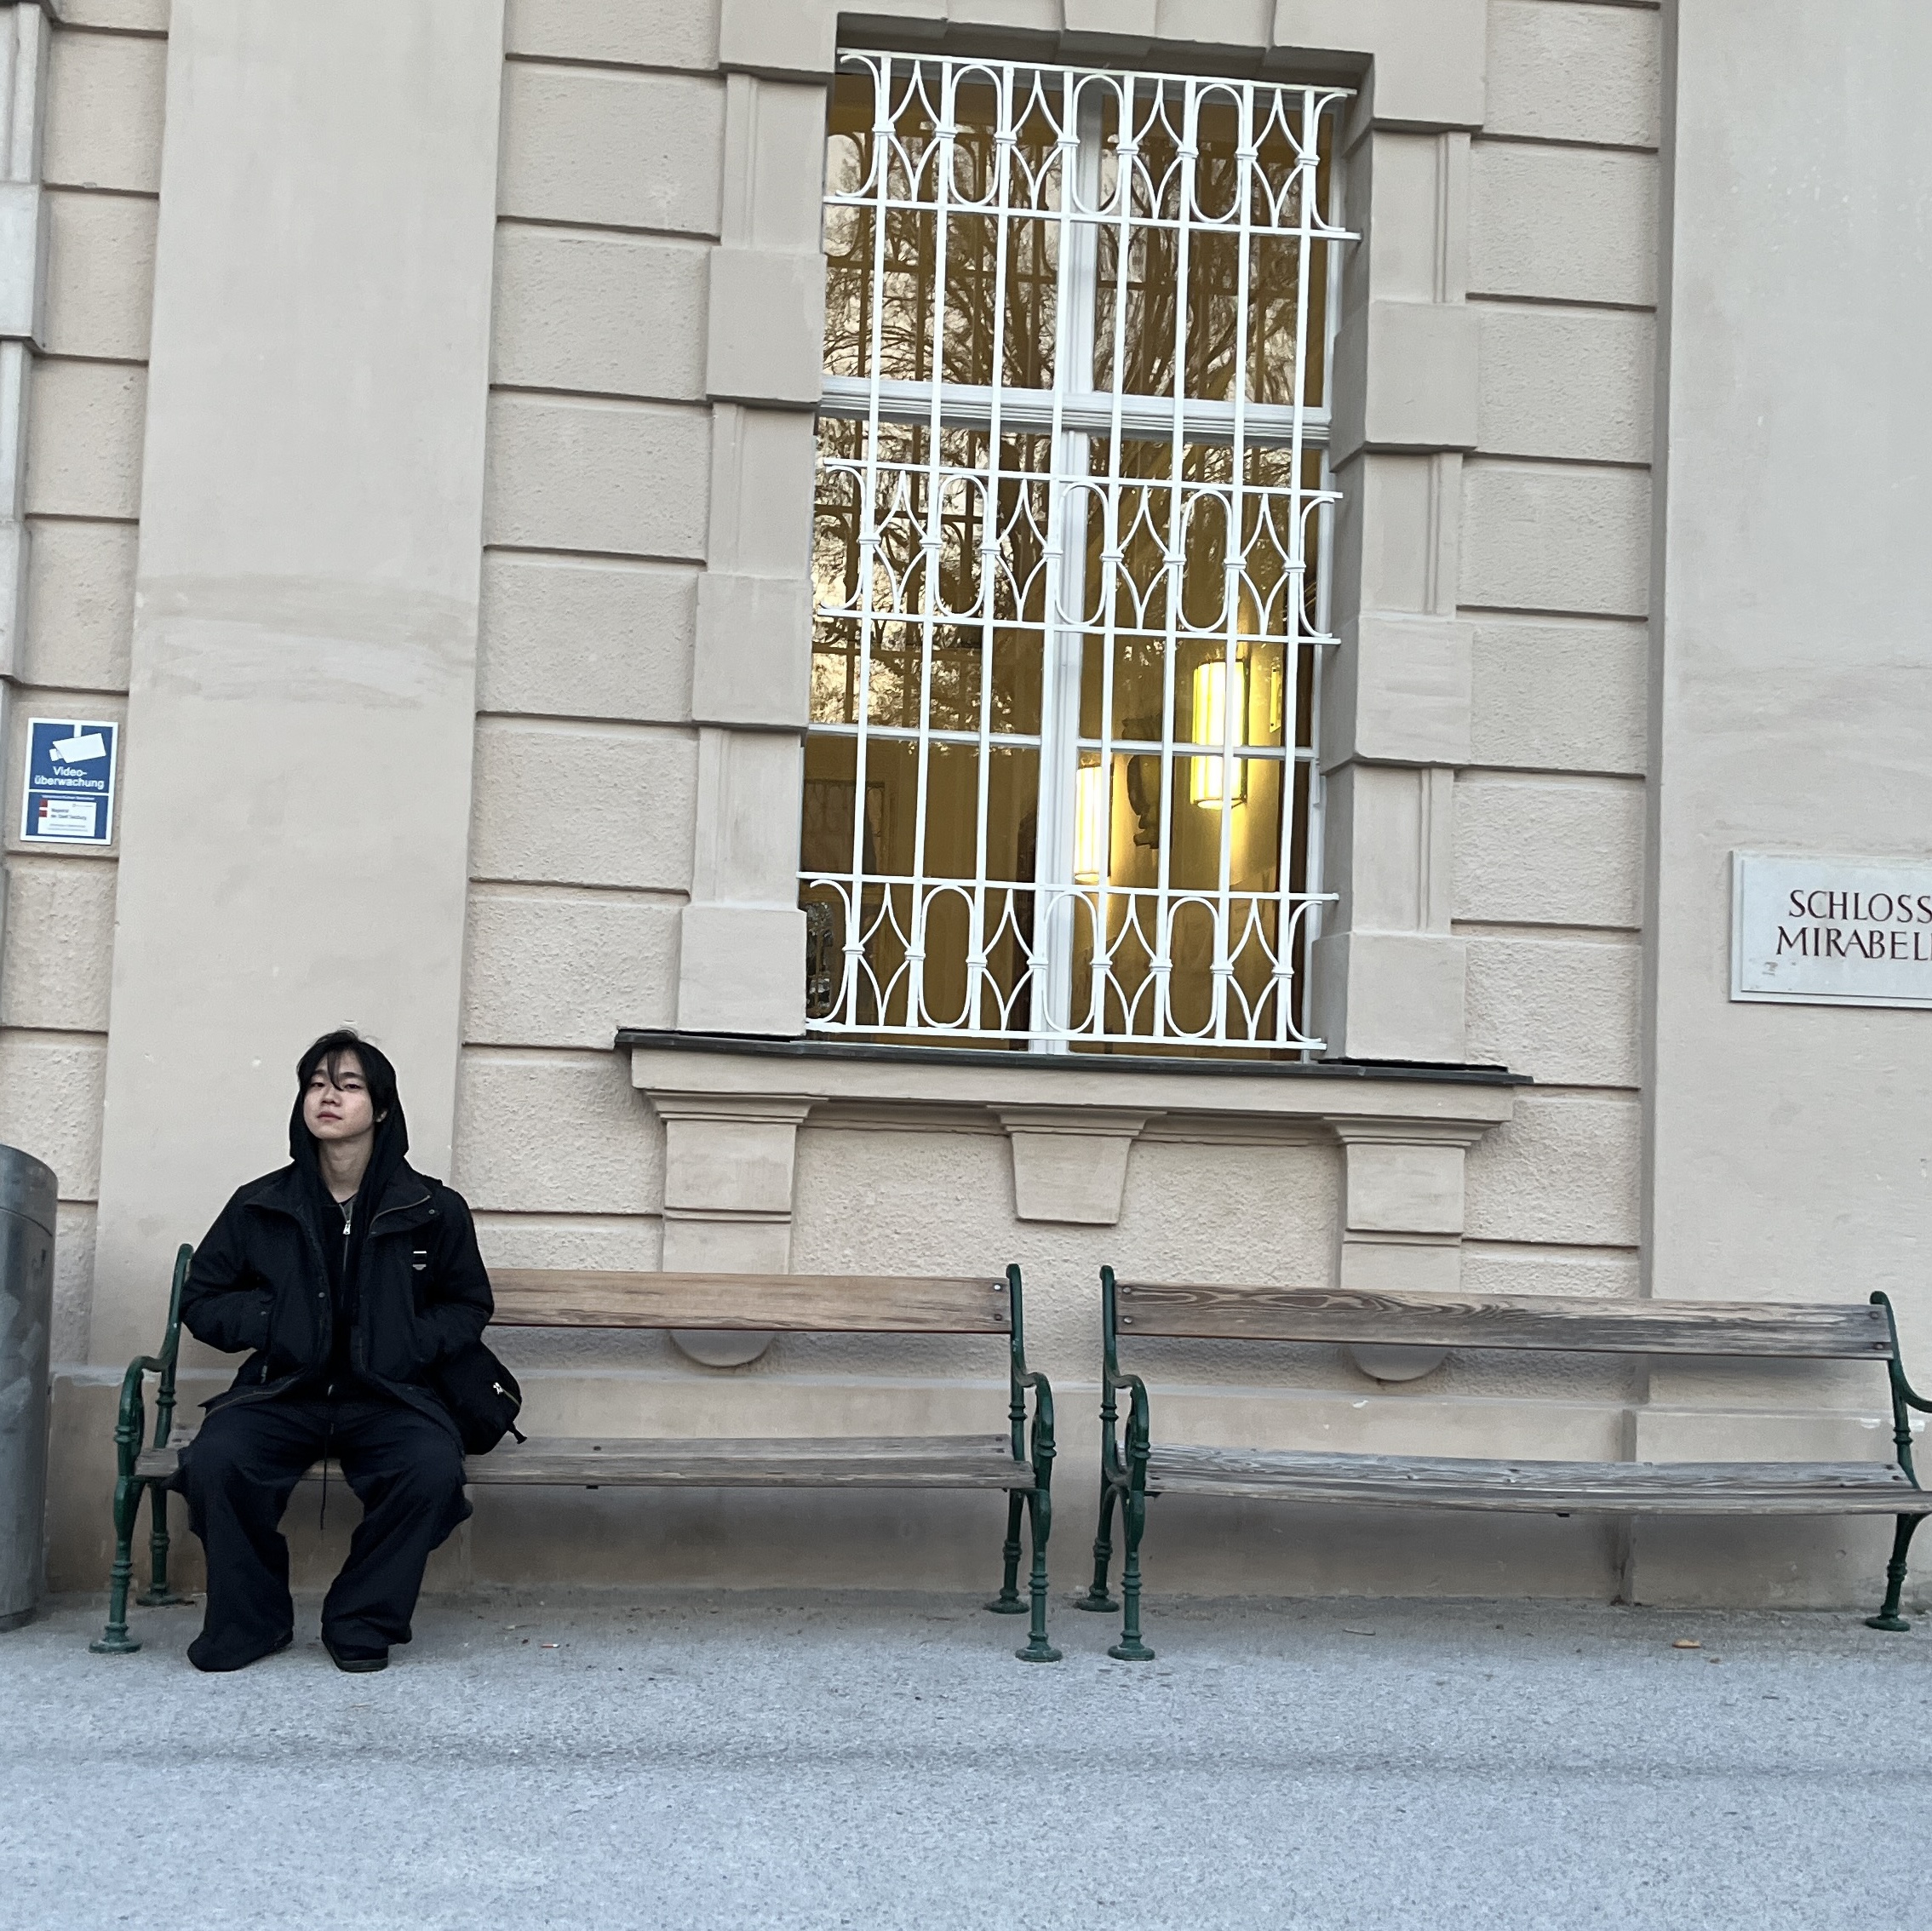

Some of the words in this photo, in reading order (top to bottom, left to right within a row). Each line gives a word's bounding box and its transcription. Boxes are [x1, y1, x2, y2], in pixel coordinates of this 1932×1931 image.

[34, 776, 104, 790] überwachung
[53, 766, 87, 776] Video-
[1789, 890, 1932, 924] SCHLOSS
[1775, 925, 1932, 961] MIRABEL
